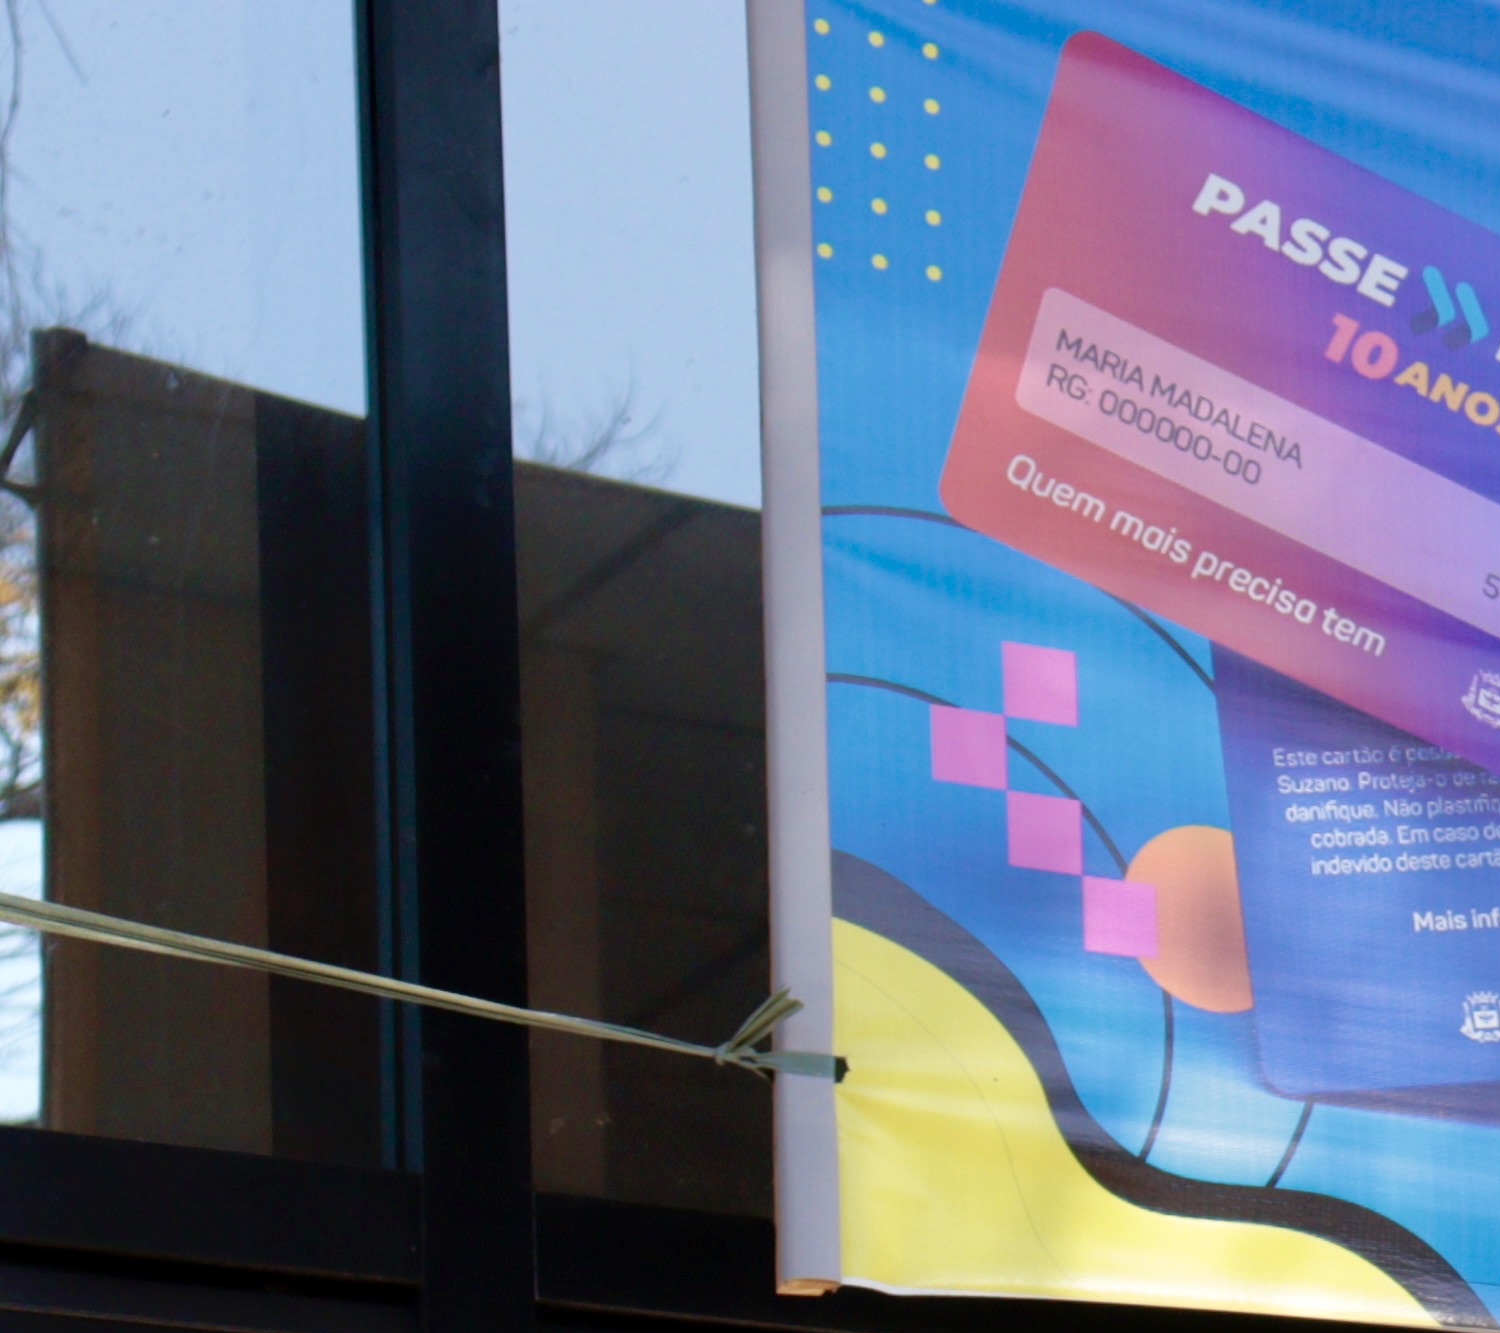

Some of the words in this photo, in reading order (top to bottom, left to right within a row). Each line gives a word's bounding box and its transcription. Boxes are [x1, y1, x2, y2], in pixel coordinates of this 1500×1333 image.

[1193, 173, 1408, 306] PASSE
[1325, 313, 1398, 380] 10
[1056, 329, 1145, 391] MARIA
[1150, 374, 1302, 468] MADALENA
[1047, 364, 1092, 405] RG:
[1099, 389, 1262, 484] 000000-00
[1006, 454, 1105, 522] Quem
[1110, 509, 1192, 564] mais
[1191, 550, 1315, 624] precisa
[1322, 606, 1386, 656] tem
[1273, 748, 1318, 767] Este
[1285, 799, 1379, 823] danifique.
[1383, 799, 1422, 817] Não
[1311, 826, 1391, 848] cobrada.
[1397, 825, 1429, 844] Em
[1433, 825, 1479, 842] caso
[1311, 853, 1391, 876] indevido
[1396, 850, 1450, 870] deste
[1413, 909, 1468, 932] Mais
